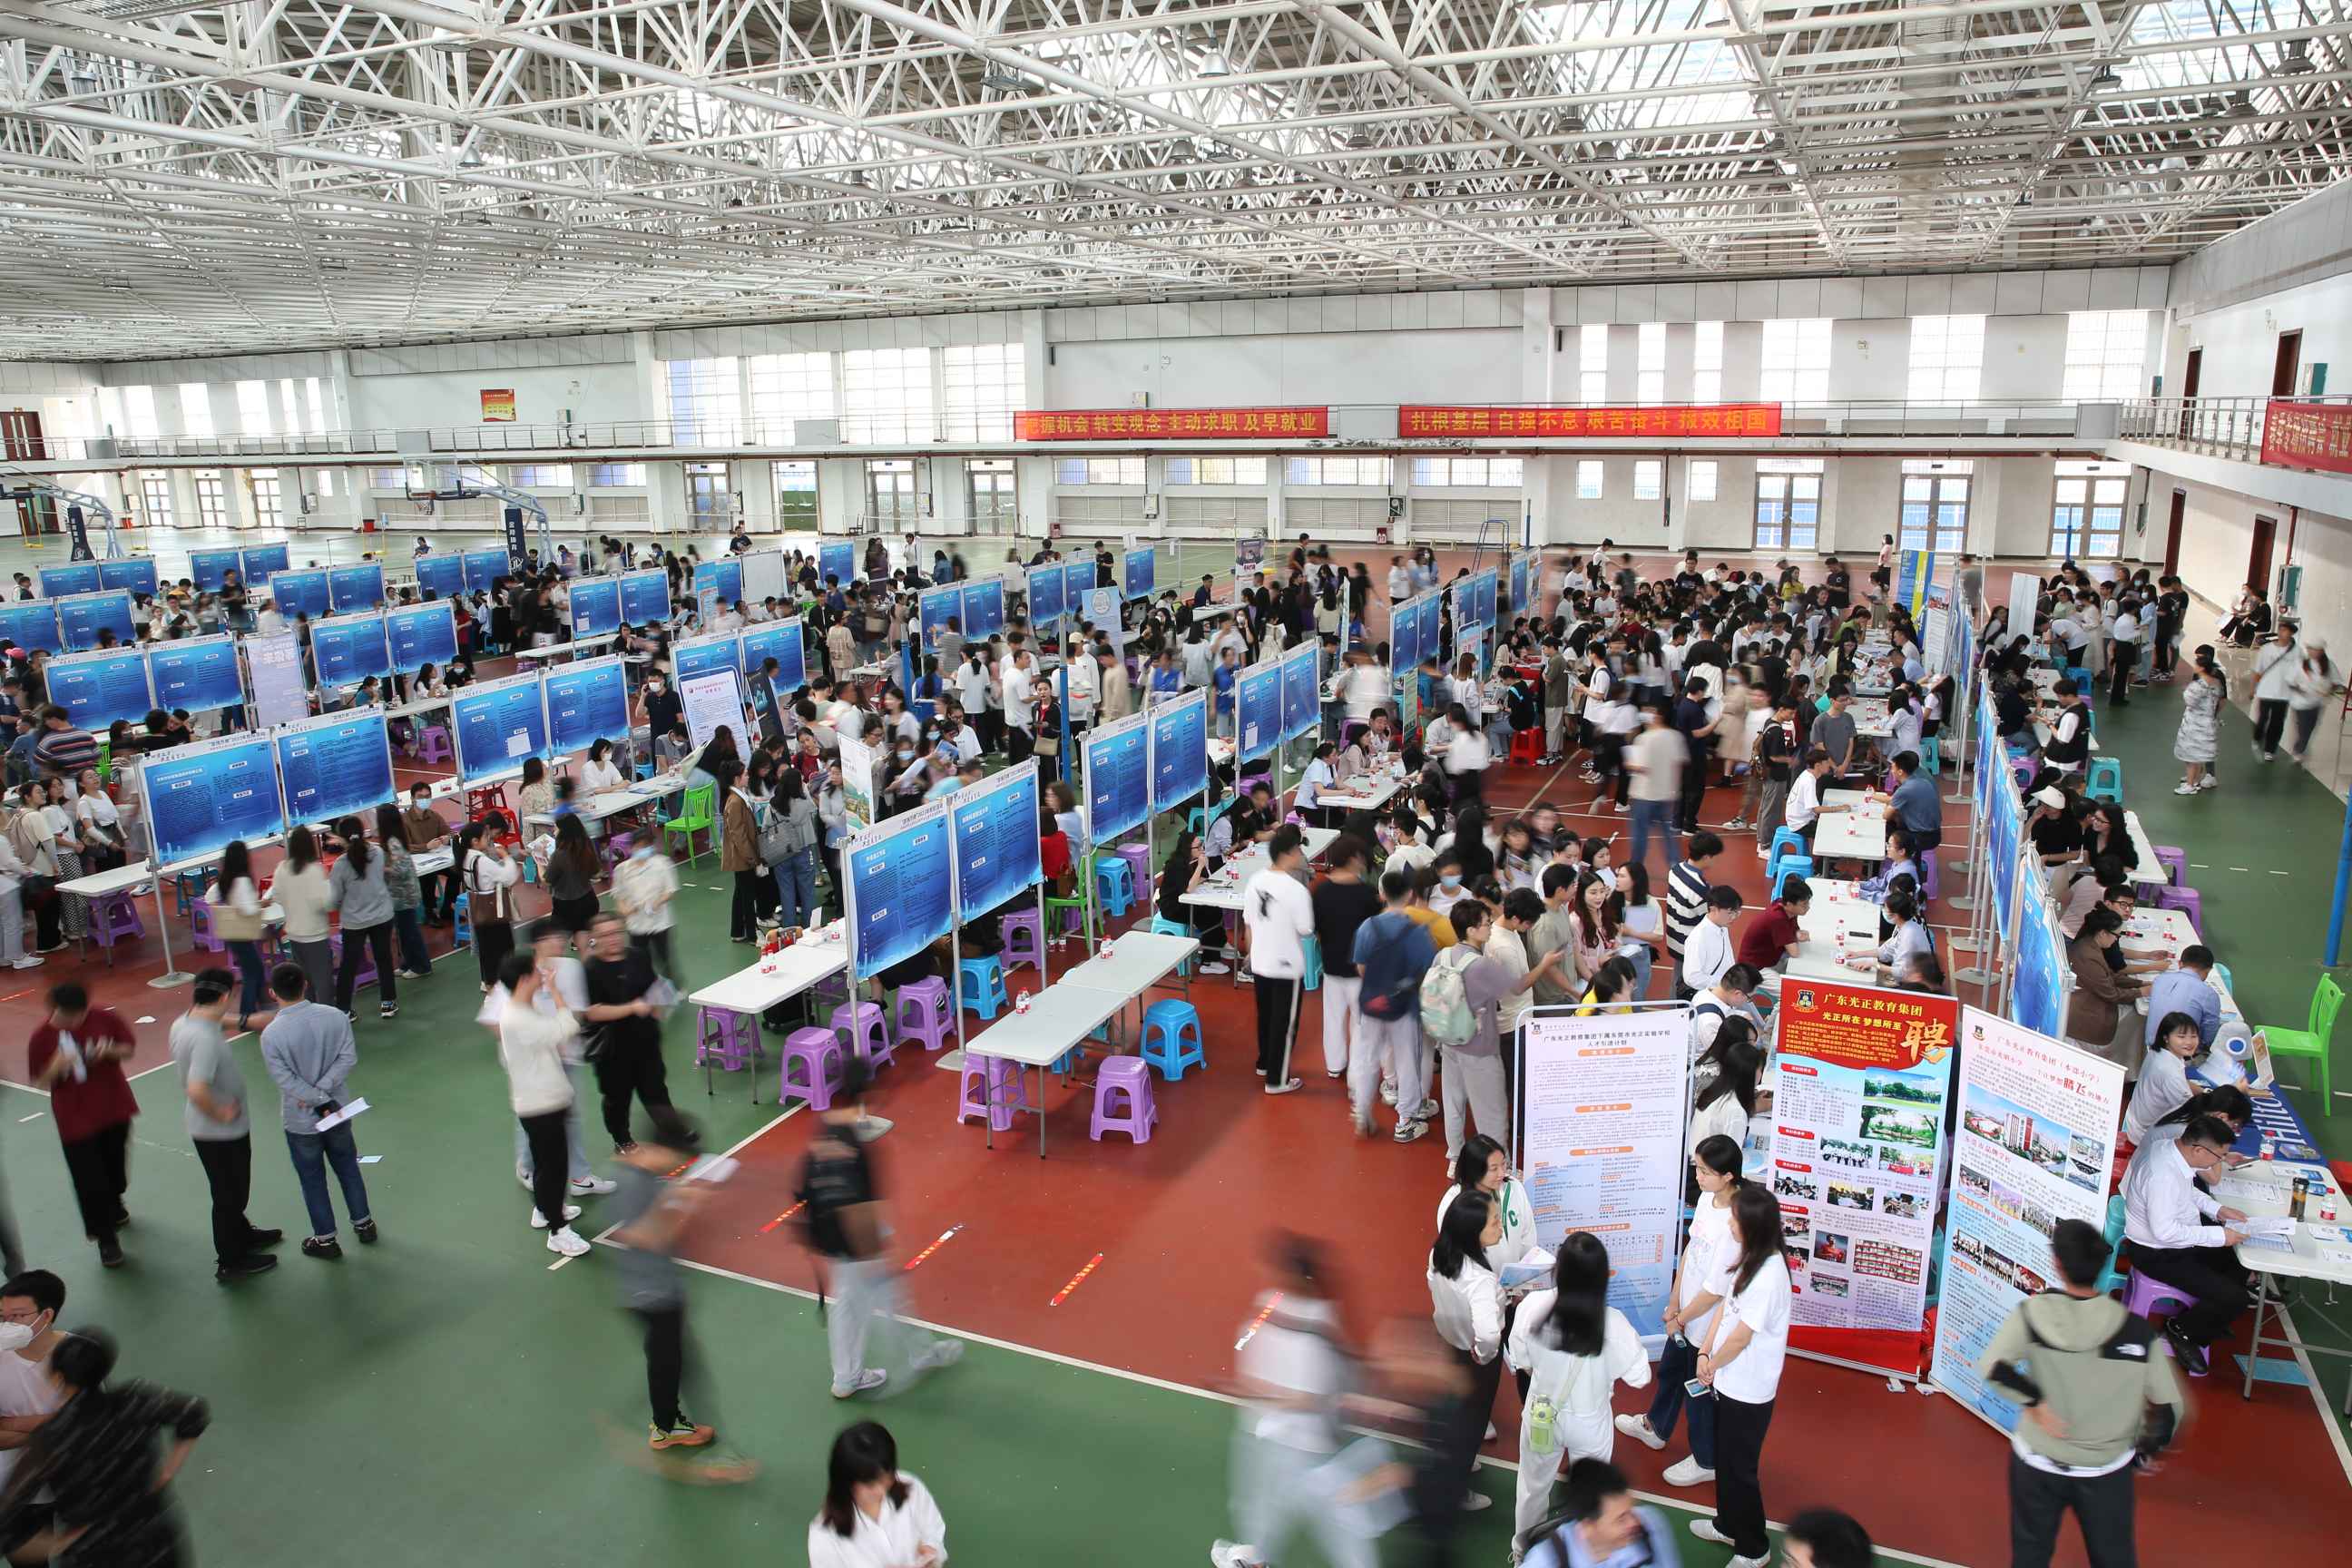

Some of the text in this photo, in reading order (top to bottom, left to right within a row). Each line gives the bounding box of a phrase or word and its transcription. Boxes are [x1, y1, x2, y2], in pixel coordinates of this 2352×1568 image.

[1093, 413, 1161, 434] 转变观念
[1168, 412, 1239, 433] 主动求职
[1244, 412, 1317, 433] 及早就业
[1411, 409, 1768, 431] 扎根基层 自强不息 艰苦奋斗 报效祖国
[1823, 993, 1923, 1017] 广东光正教育集团
[1822, 1011, 1902, 1032] 光正所在 梦想所至
[1900, 1017, 1948, 1063] 聘
[2250, 1092, 2307, 1145] Hilto
